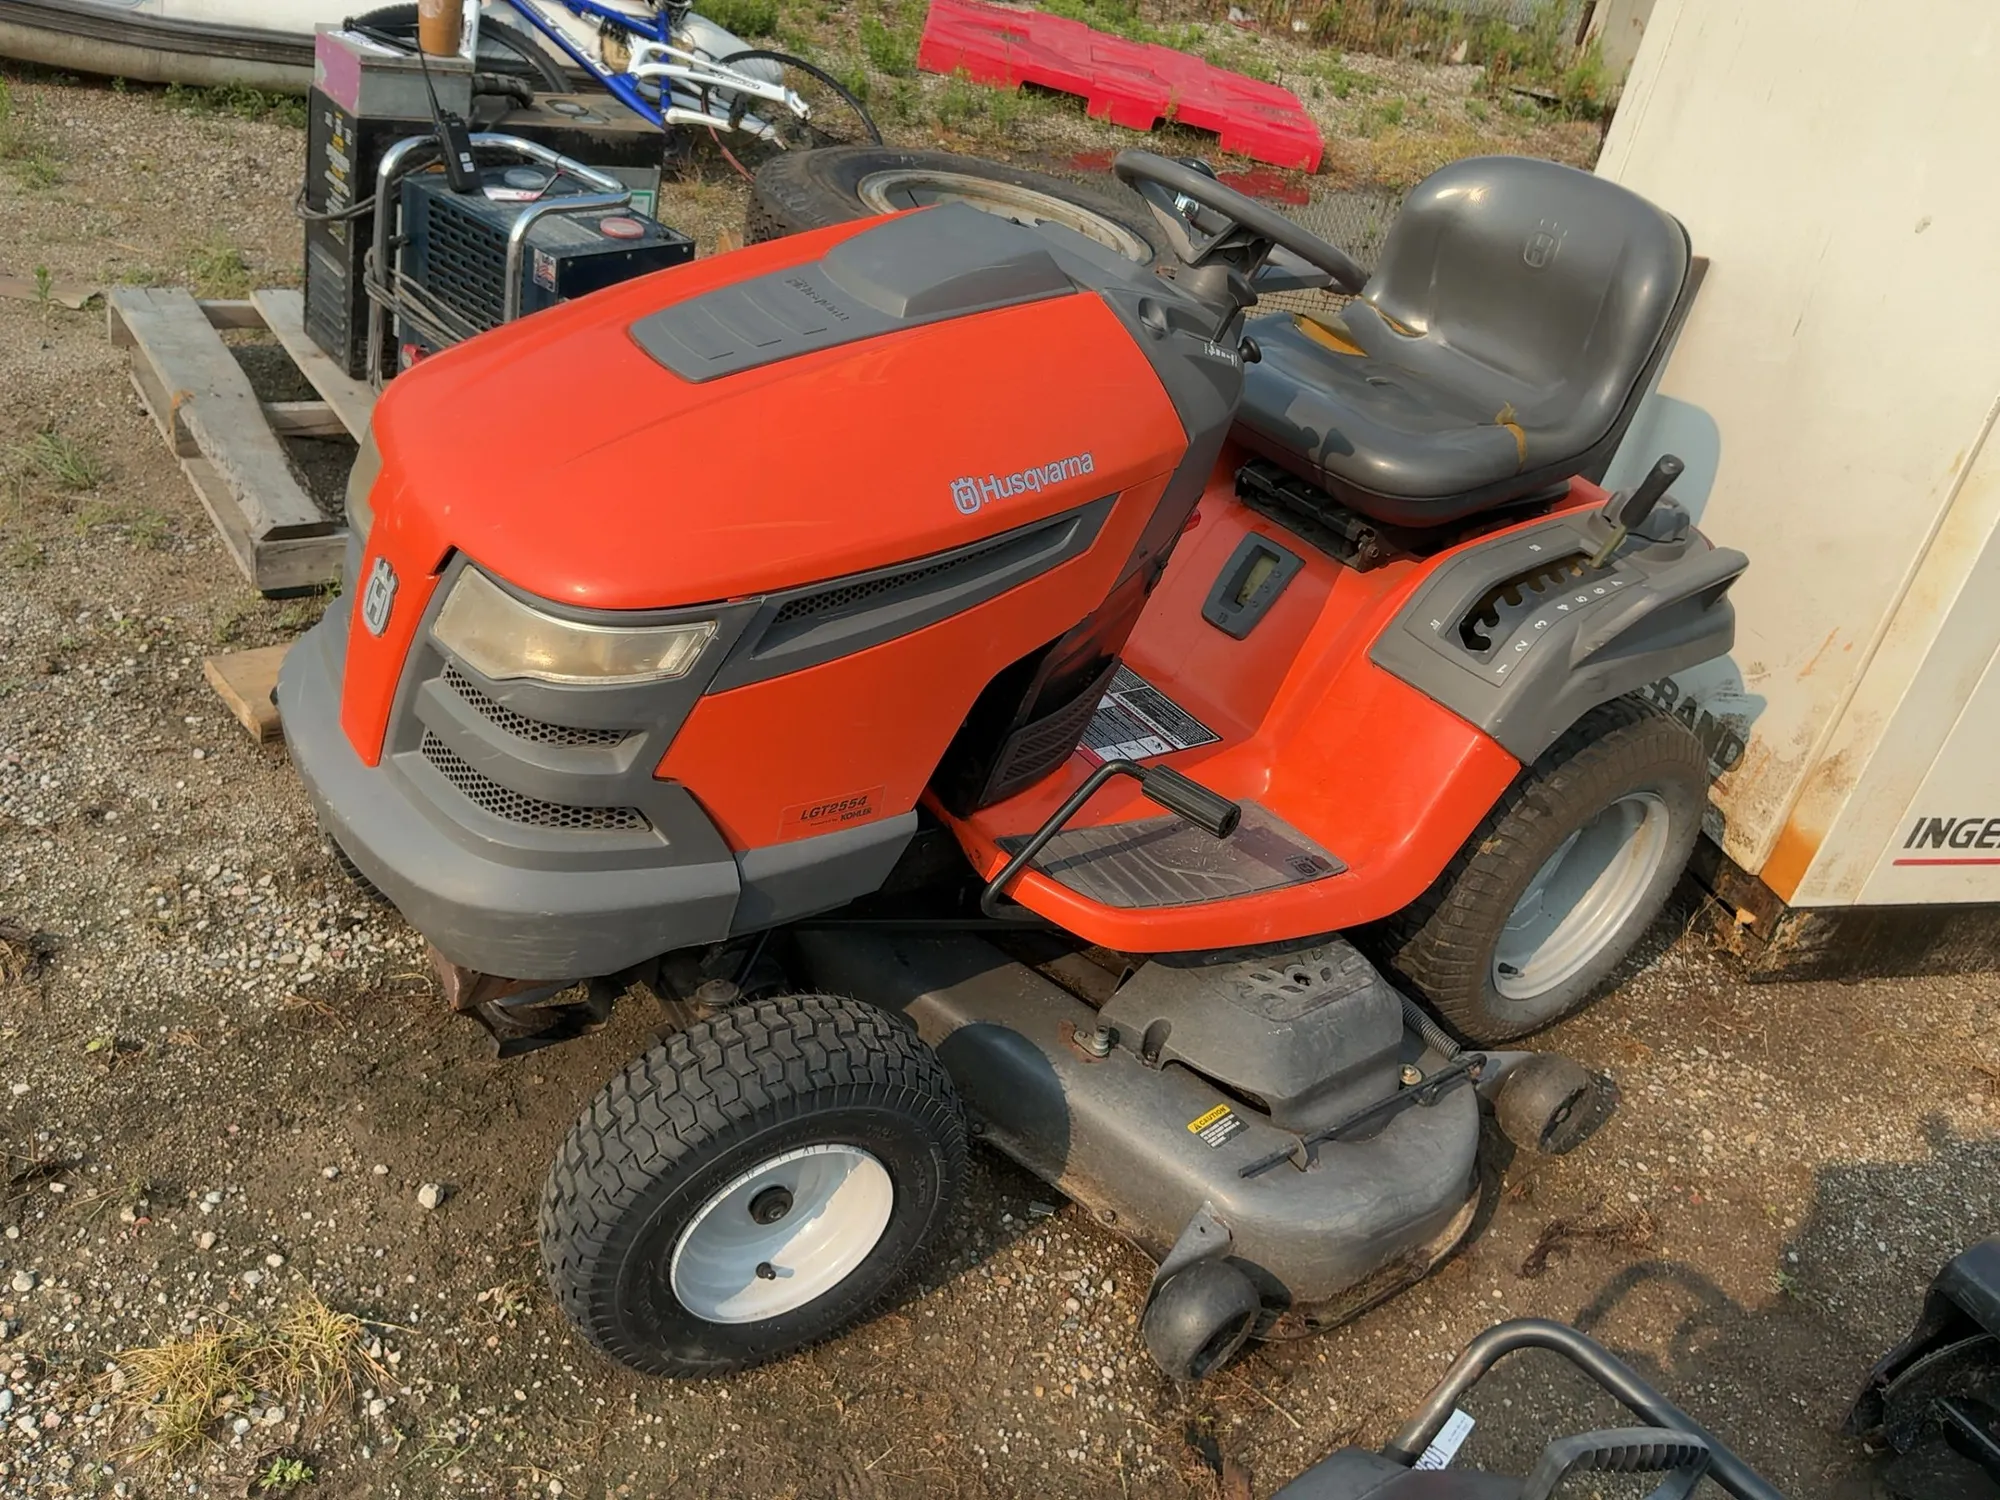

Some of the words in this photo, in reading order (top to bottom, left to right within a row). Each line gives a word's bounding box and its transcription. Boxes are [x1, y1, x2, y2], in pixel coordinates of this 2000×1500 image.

[978, 452, 1095, 503] Husqvarna
[801, 795, 867, 820] LGT2554
[840, 807, 872, 821] KOHLER
[1902, 817, 2000, 849] INGE
[1199, 1106, 1227, 1126] CAUTION
